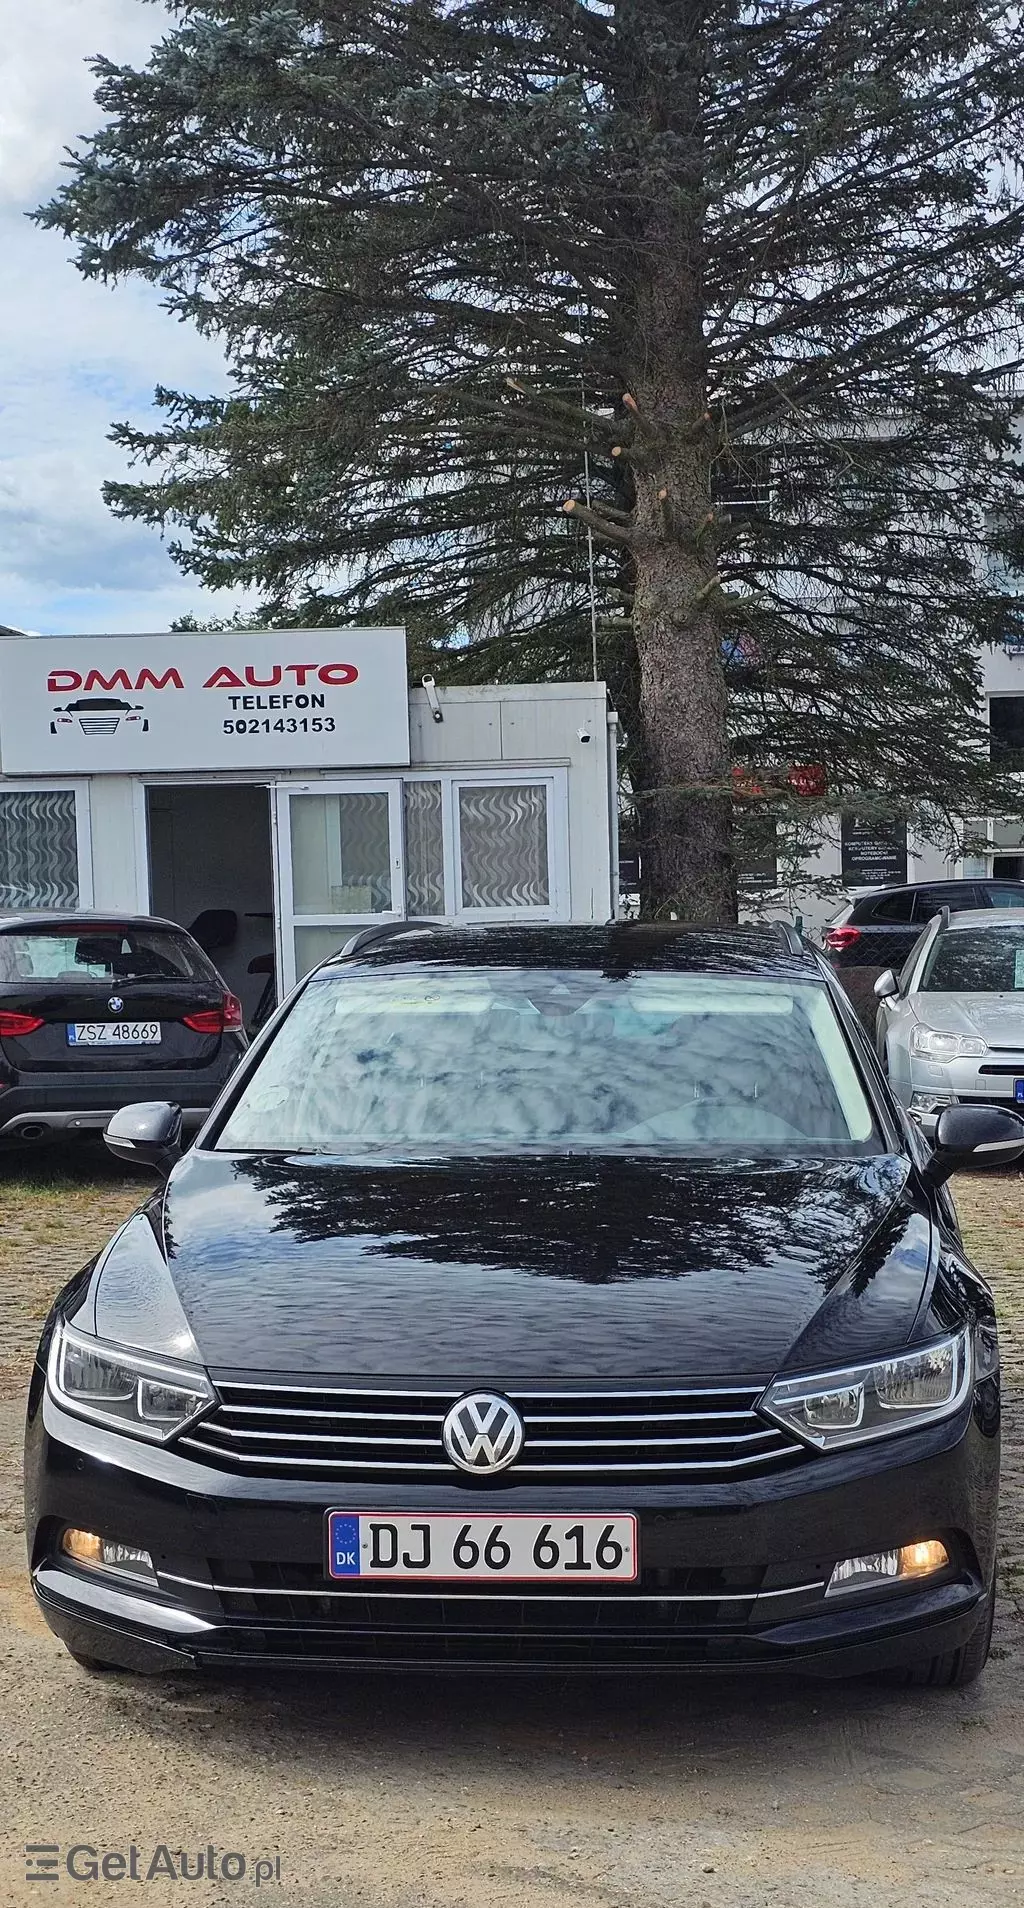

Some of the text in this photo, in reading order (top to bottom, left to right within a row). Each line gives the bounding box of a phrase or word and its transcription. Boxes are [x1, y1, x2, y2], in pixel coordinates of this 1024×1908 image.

[47, 663, 359, 692] DMM AUTO
[228, 693, 325, 710] TELEFON
[223, 717, 336, 735] 502143153
[76, 1024, 158, 1040] ZSZ 48669
[369, 1523, 623, 1570] DJ 66 616
[336, 1551, 356, 1565] DK
